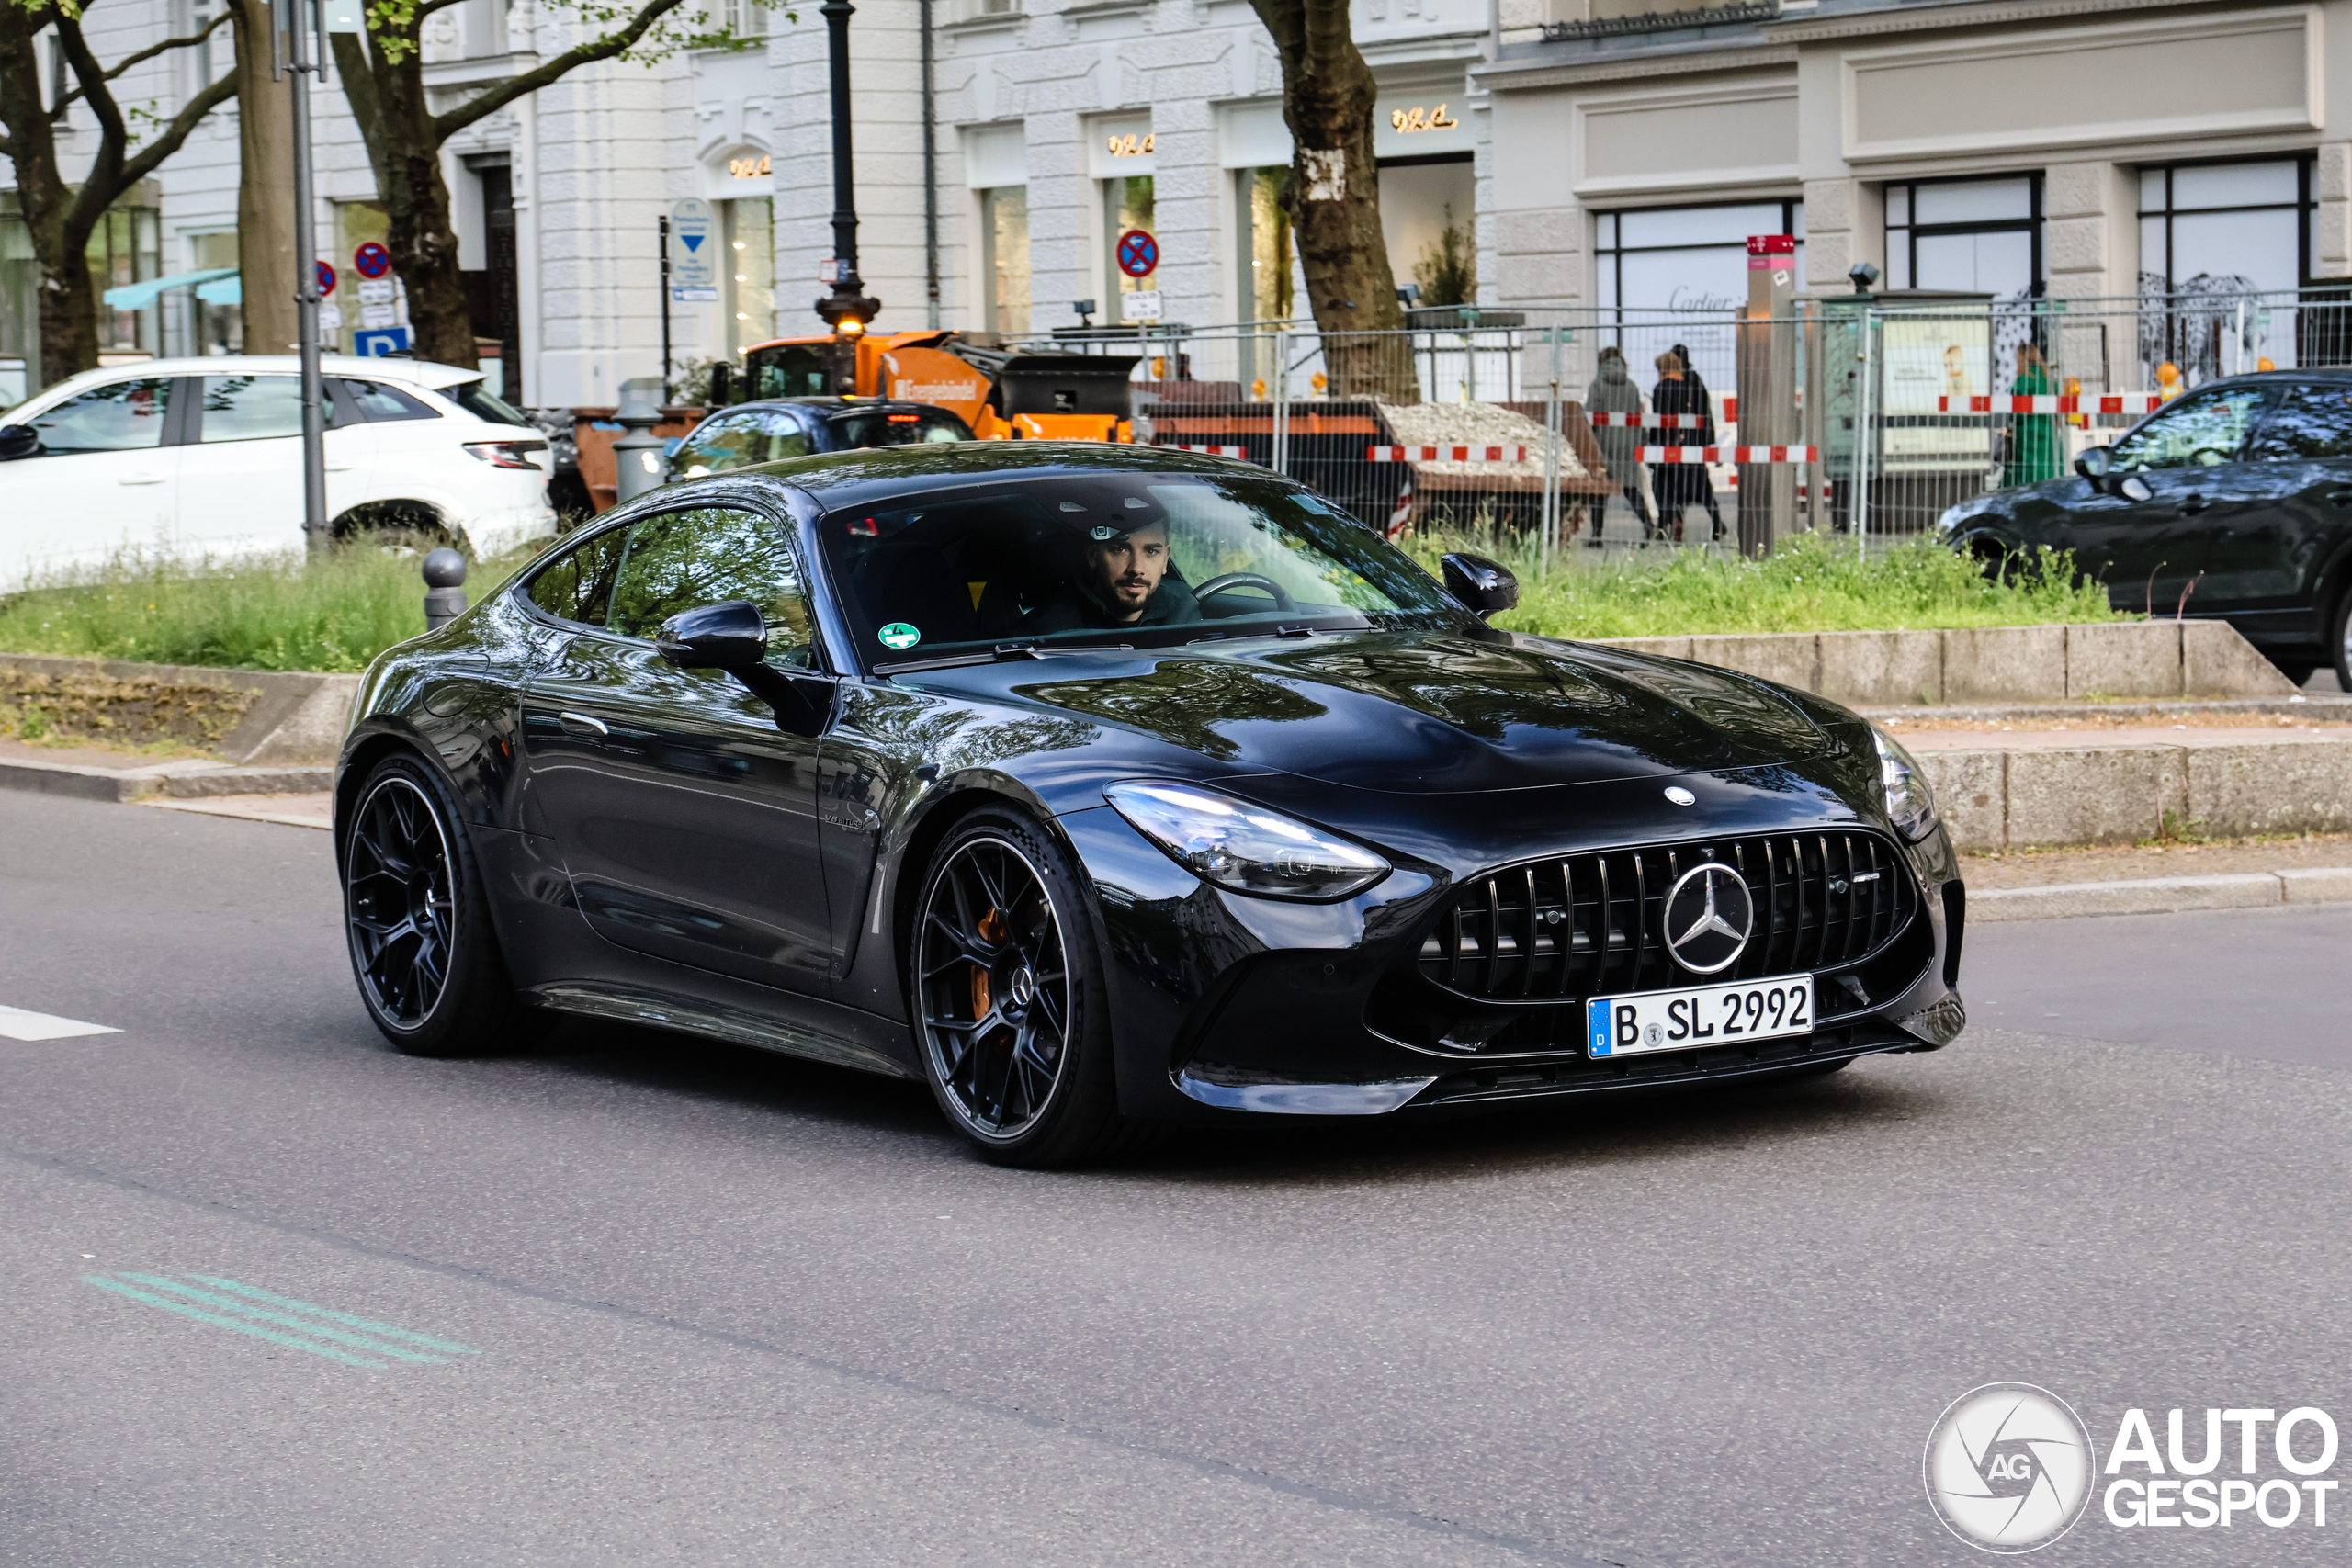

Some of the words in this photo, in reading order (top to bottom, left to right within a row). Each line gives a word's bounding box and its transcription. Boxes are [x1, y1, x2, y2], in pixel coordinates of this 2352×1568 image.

[1669, 284, 1734, 314] Cartier
[367, 335, 397, 356] P
[893, 625, 904, 635] 4
[1616, 1004, 1639, 1046] B
[1668, 998, 1714, 1041] SL
[1724, 985, 1808, 1035] 2992
[1596, 1033, 1605, 1046] D
